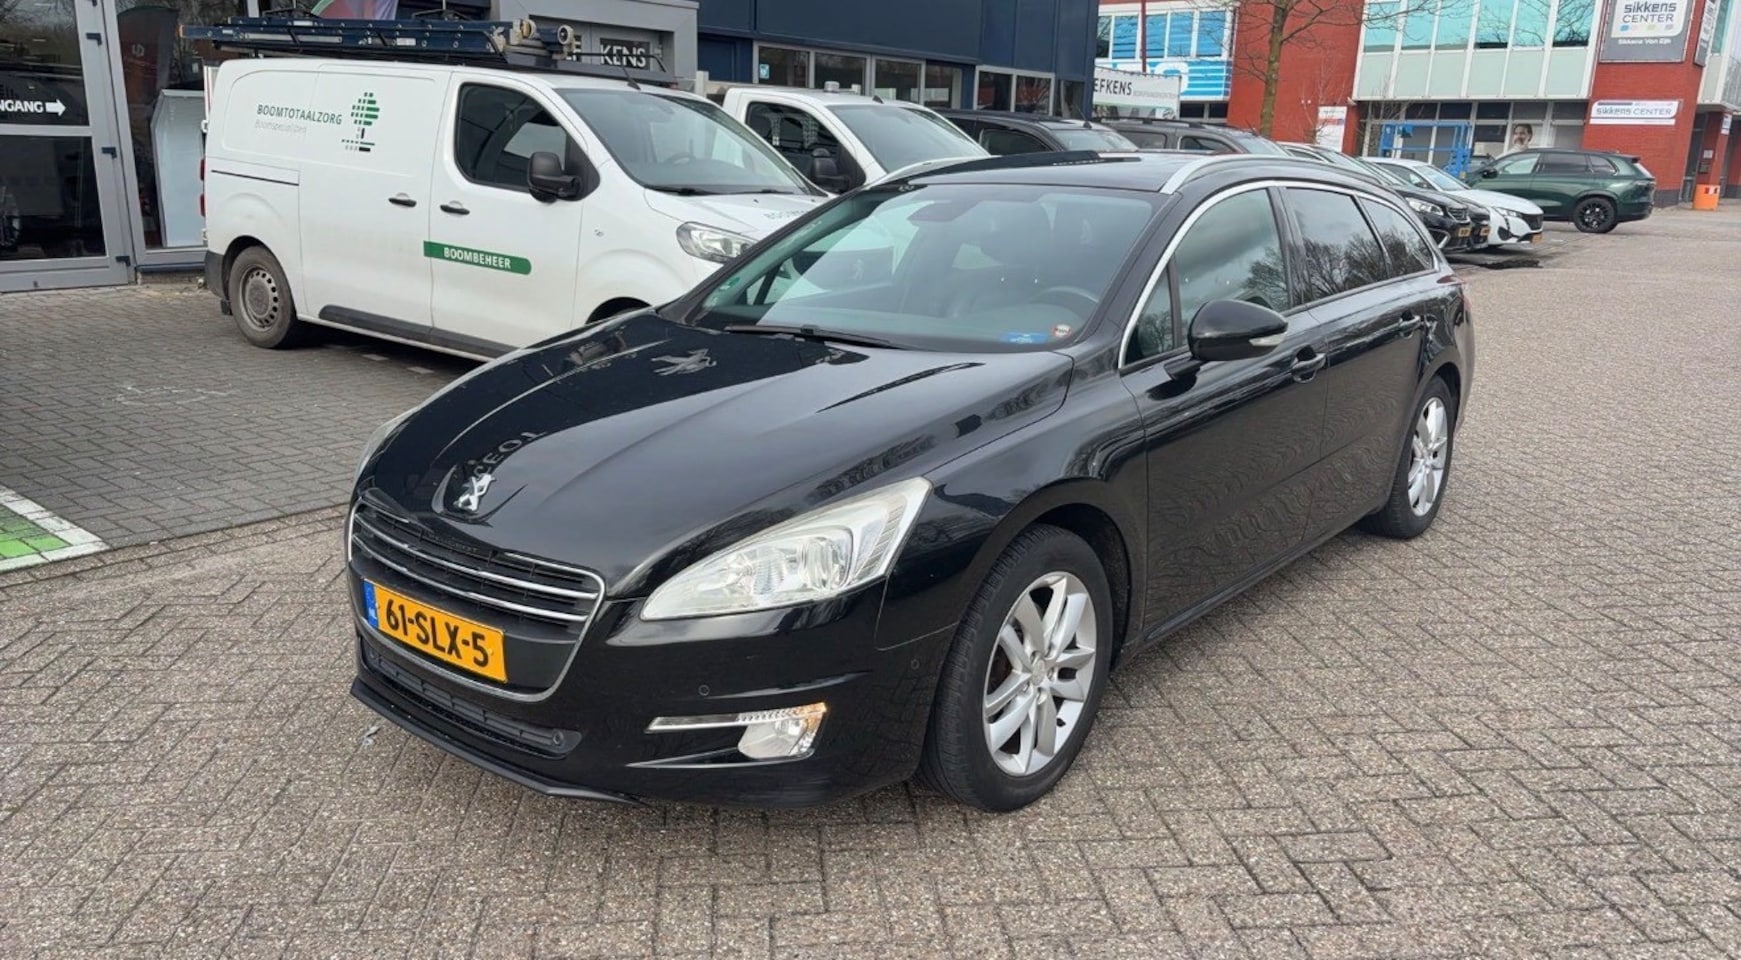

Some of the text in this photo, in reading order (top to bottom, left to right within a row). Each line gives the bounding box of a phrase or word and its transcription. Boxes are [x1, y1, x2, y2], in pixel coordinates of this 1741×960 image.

[1623, 1, 1677, 13] sikkens
[1622, 13, 1675, 24] CENTER
[256, 104, 343, 125] BOOMTOTAALZORG
[1633, 107, 1672, 116] CENTER
[443, 247, 511, 269] BOOMBEHEER
[386, 598, 489, 668] 61-SLX-5
